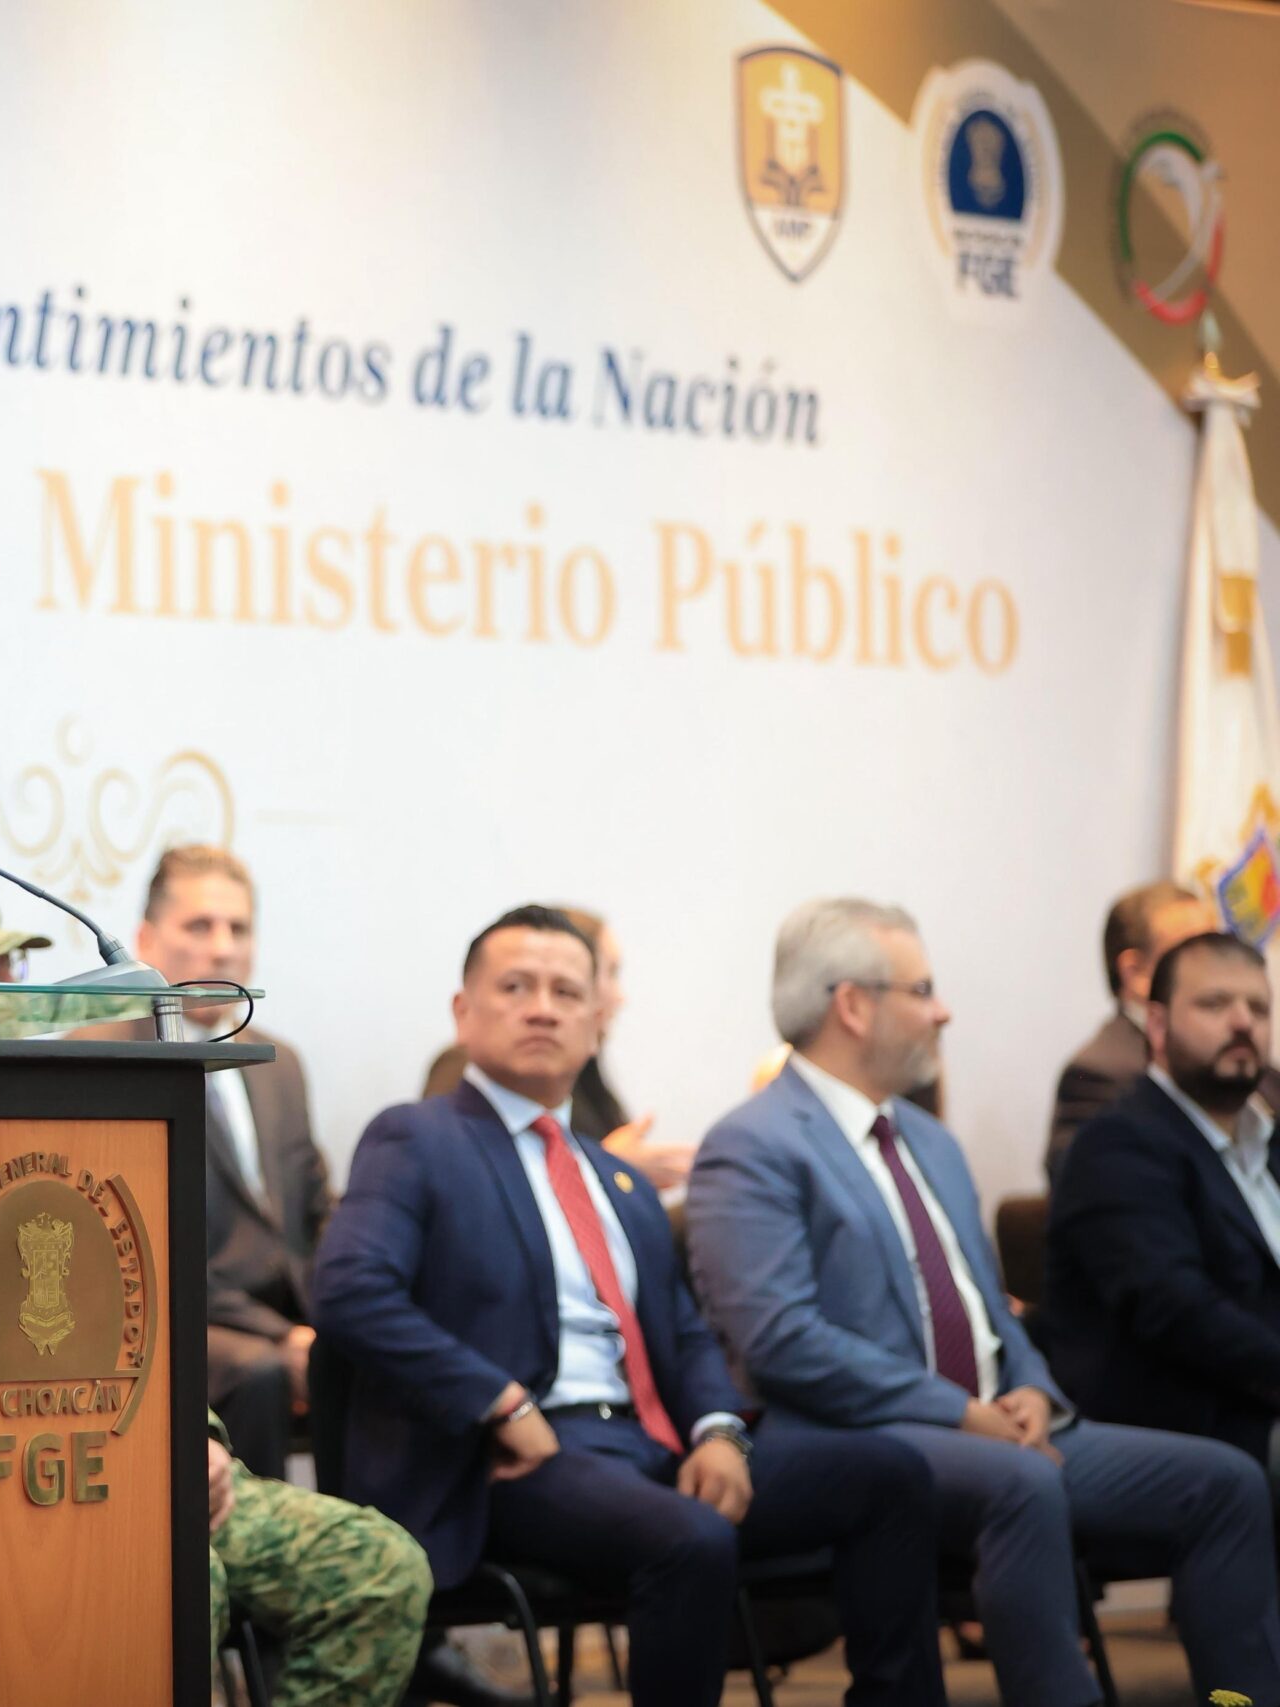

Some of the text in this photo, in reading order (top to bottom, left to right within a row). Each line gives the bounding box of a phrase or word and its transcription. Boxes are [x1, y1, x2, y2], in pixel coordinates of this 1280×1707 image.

[412, 323, 492, 413] de
[512, 331, 578, 423] la
[591, 345, 822, 448] Nación
[34, 468, 618, 650] Ministerio
[653, 518, 1021, 675] Público
[76, 1168, 111, 1218] DEL
[109, 1217, 142, 1344] ESTADO
